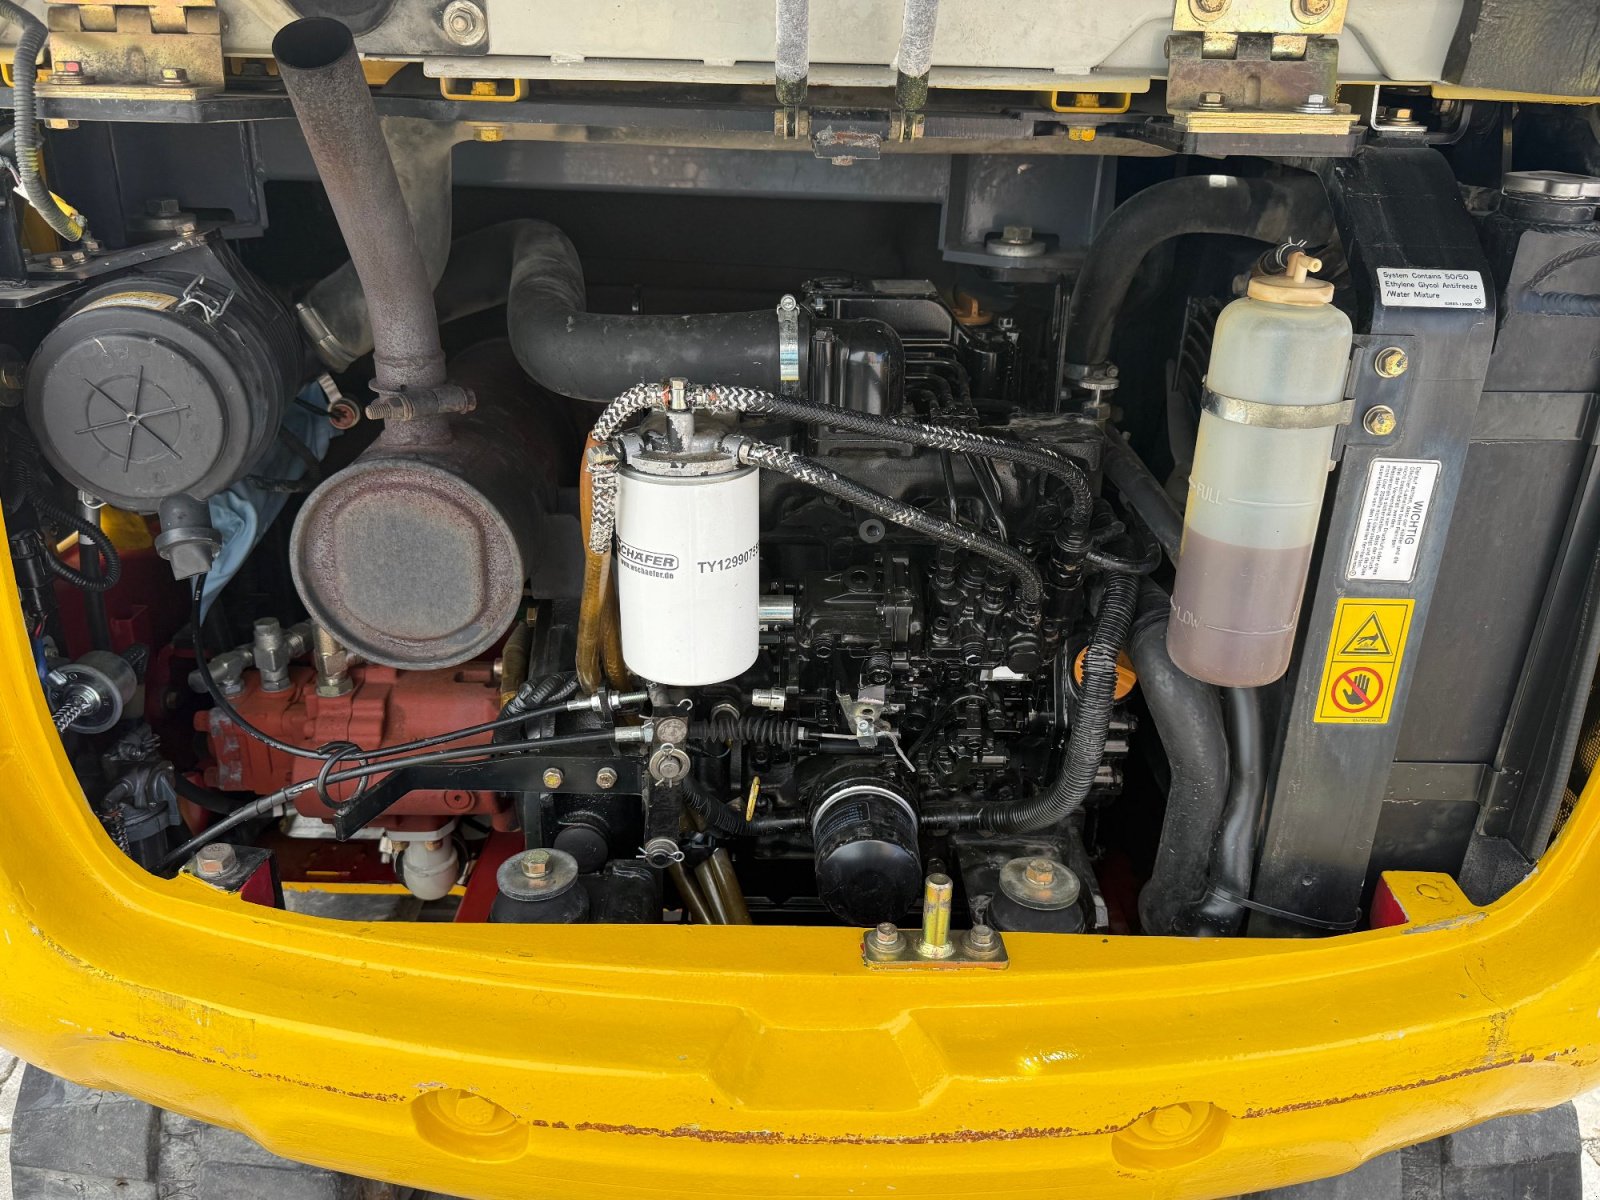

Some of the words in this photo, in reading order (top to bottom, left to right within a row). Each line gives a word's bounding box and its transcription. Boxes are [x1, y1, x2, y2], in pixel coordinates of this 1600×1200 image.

[1383, 271, 1408, 279] System
[1385, 280, 1415, 288] Ethylene
[1418, 281, 1439, 289] Glycol
[1442, 282, 1478, 290] Antifreeze
[1413, 291, 1440, 299] Mixture
[1195, 481, 1222, 505] FULL
[1403, 500, 1424, 545] WICHTIG
[1177, 606, 1201, 629] LOW
